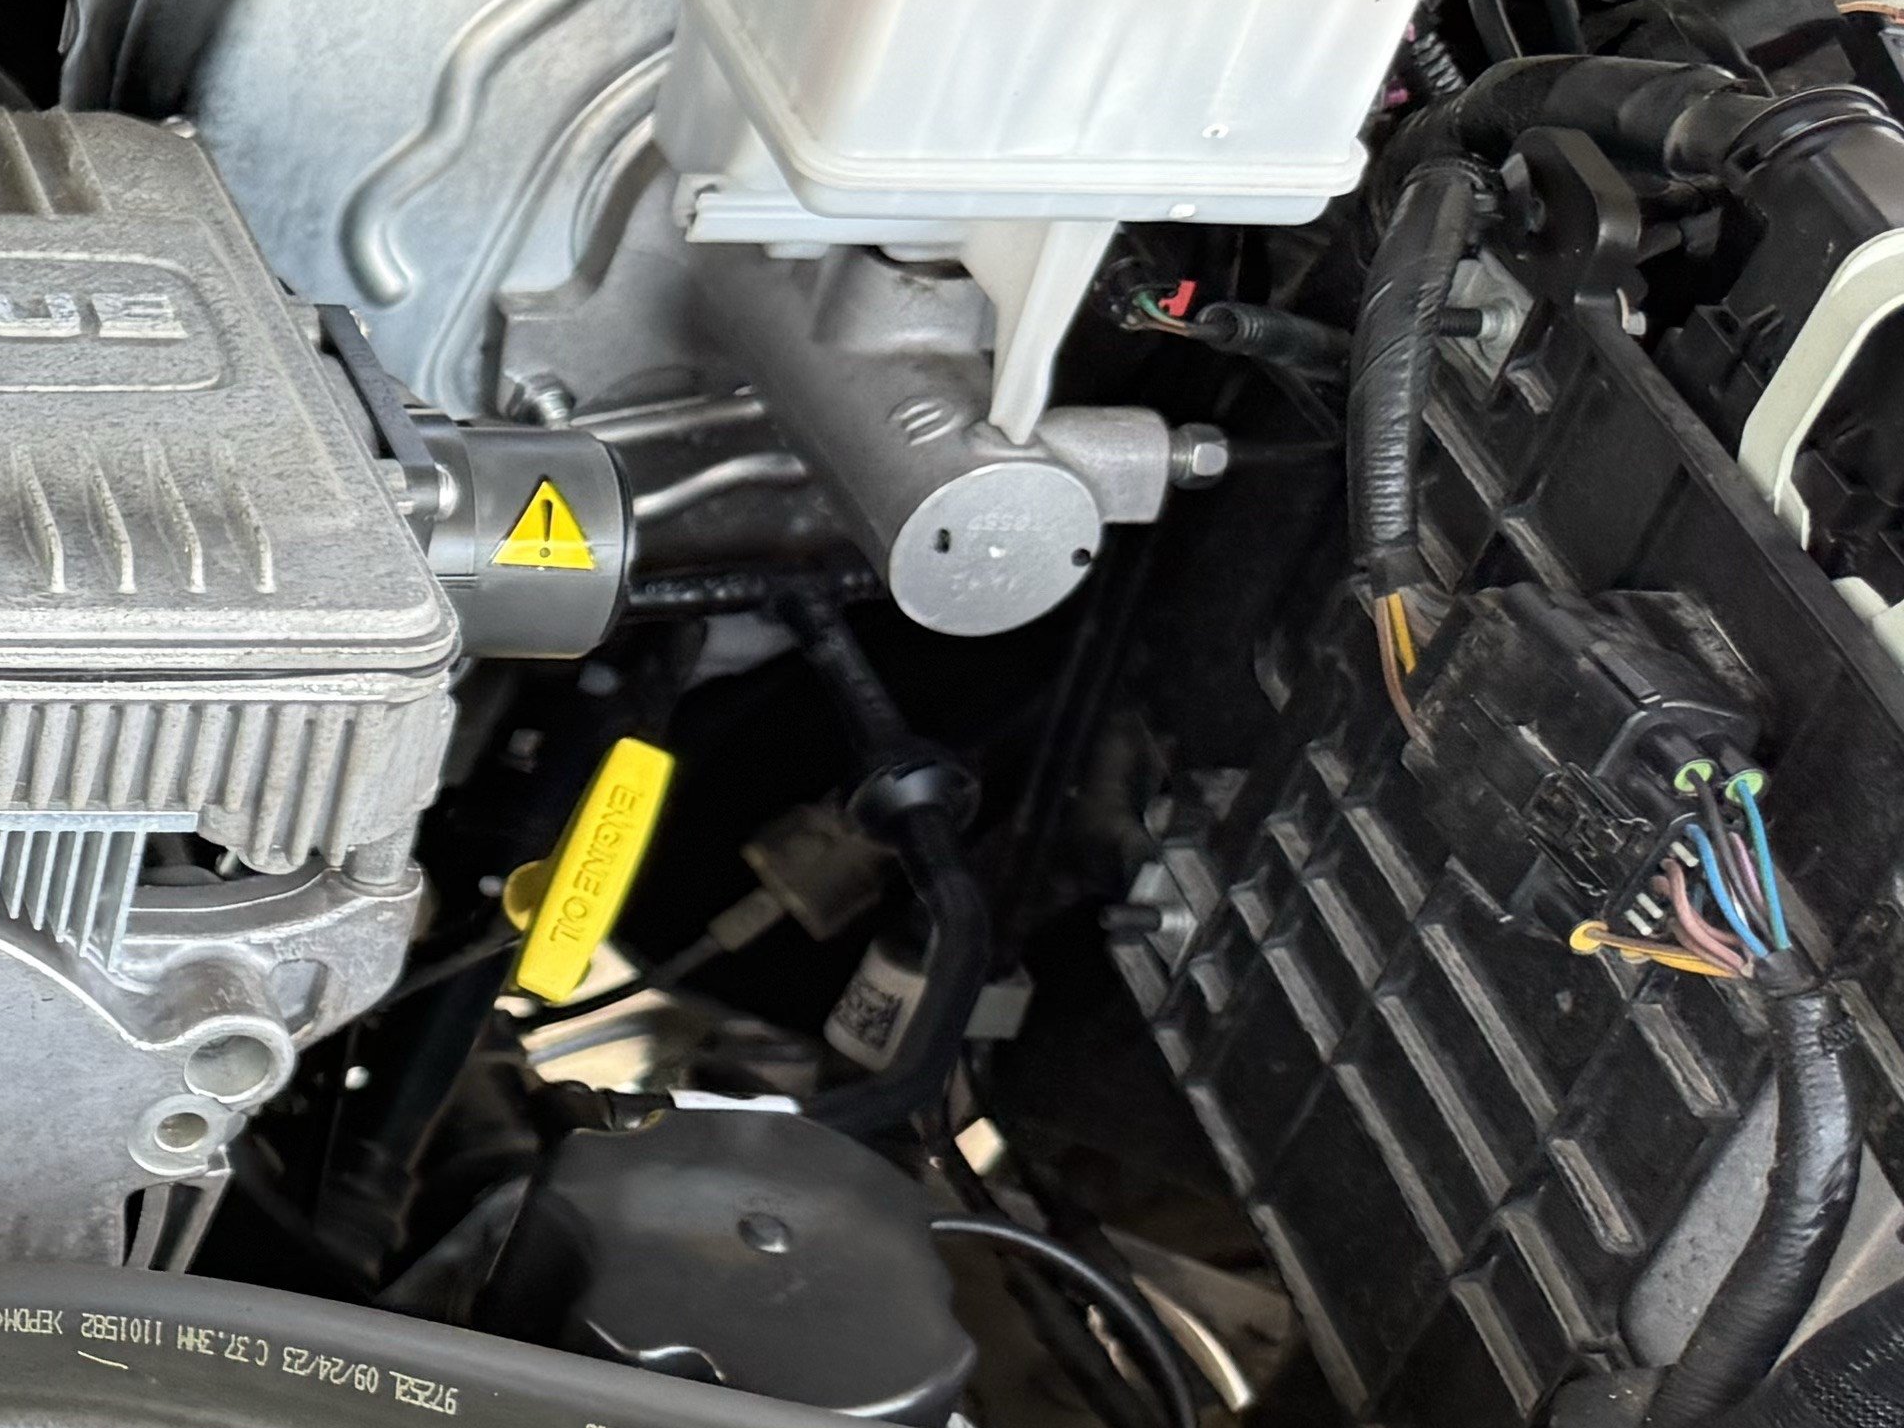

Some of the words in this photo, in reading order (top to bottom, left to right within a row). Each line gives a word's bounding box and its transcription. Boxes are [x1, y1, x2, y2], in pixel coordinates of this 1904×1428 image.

[574, 785, 640, 897] ENGINE
[549, 894, 589, 943] OIL
[80, 1312, 163, 1346] 1101582
[283, 1346, 380, 1393] 09/24/23
